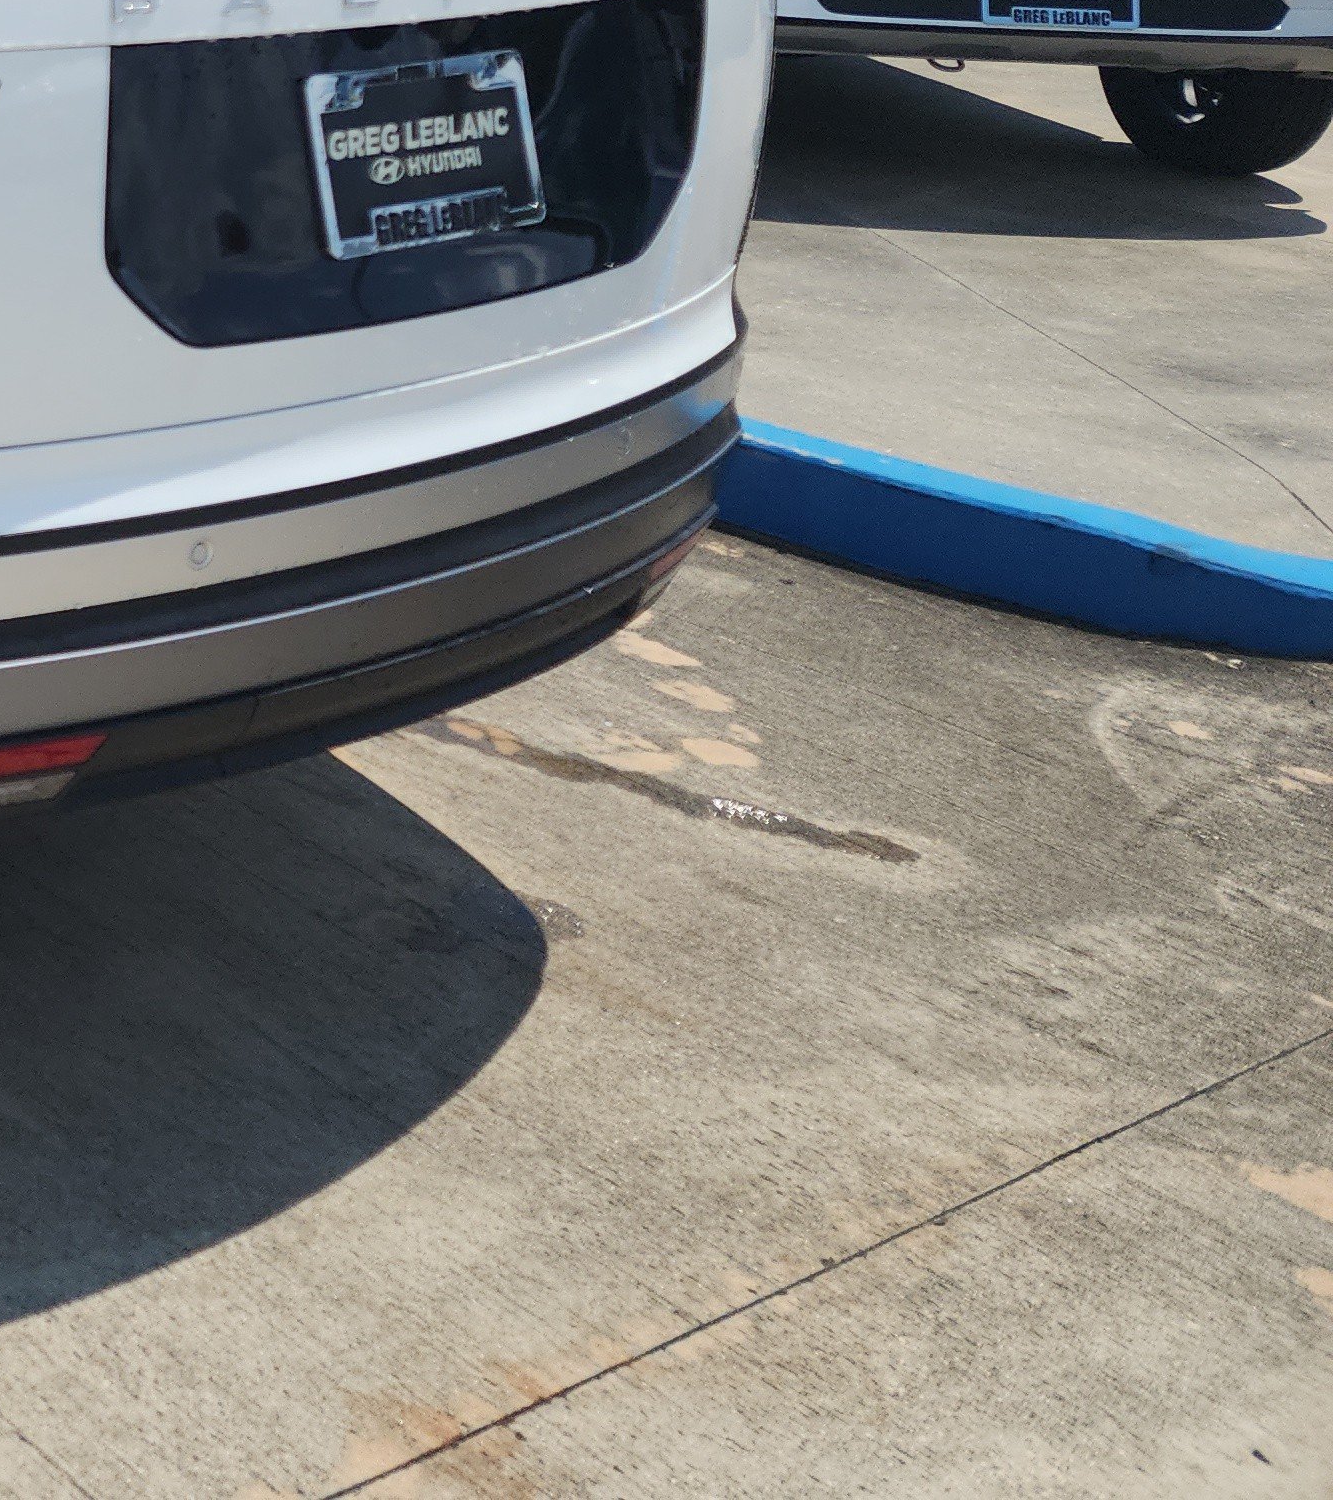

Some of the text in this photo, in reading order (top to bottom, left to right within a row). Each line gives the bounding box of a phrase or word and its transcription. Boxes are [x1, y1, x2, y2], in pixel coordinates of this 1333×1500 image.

[1013, 8, 1050, 24] GREG
[326, 106, 510, 161] GREG LEBLANC
[406, 145, 482, 177] HYUNDAI
